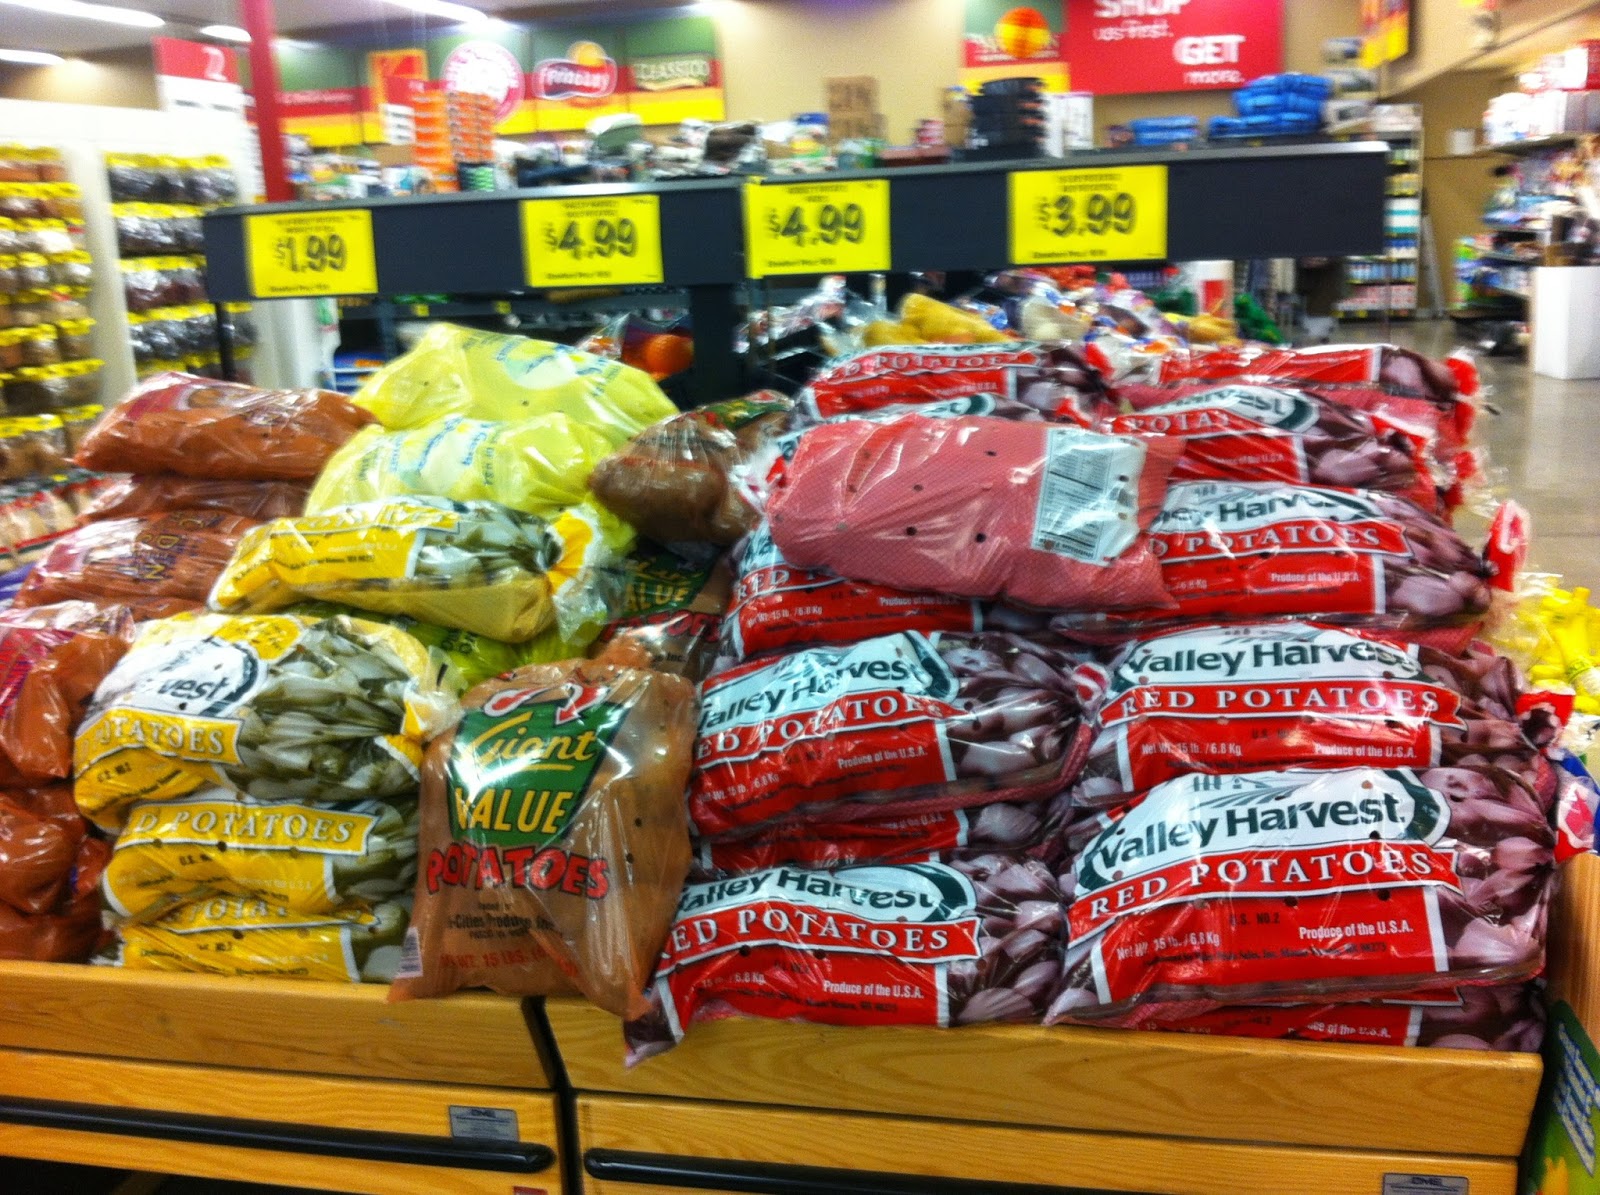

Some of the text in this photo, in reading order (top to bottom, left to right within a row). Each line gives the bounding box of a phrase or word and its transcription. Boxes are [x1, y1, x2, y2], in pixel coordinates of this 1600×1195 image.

[201, 46, 227, 80] 2
[1172, 34, 1246, 65] GET
[767, 203, 865, 247] $4.99
[1033, 192, 1137, 237] $3.99
[273, 234, 347, 272] $1.99
[541, 217, 639, 260] $4.99
[1186, 524, 1382, 553] POTATOES
[625, 581, 689, 612] ALUE
[1129, 649, 1247, 676] Valley
[1120, 687, 1440, 717] RED POTATOES
[757, 696, 942, 744] POTATOES
[838, 755, 873, 769] Produce
[1229, 743, 1242, 756] Kg
[1315, 743, 1351, 756] Produce
[1354, 744, 1364, 756] of
[1366, 745, 1383, 756] the
[171, 810, 354, 843] POTATOES
[454, 787, 575, 834] VALUE
[1100, 794, 1401, 869] Valley Harvest
[426, 842, 610, 900] POTATOES
[1089, 849, 1433, 921] RED POTATOES
[670, 910, 948, 953] ED POTATOES
[1207, 932, 1220, 948] Kg
[1299, 920, 1414, 940] Produce of the U.S.A.
[823, 980, 924, 1000] Produce of the U.S.A.
